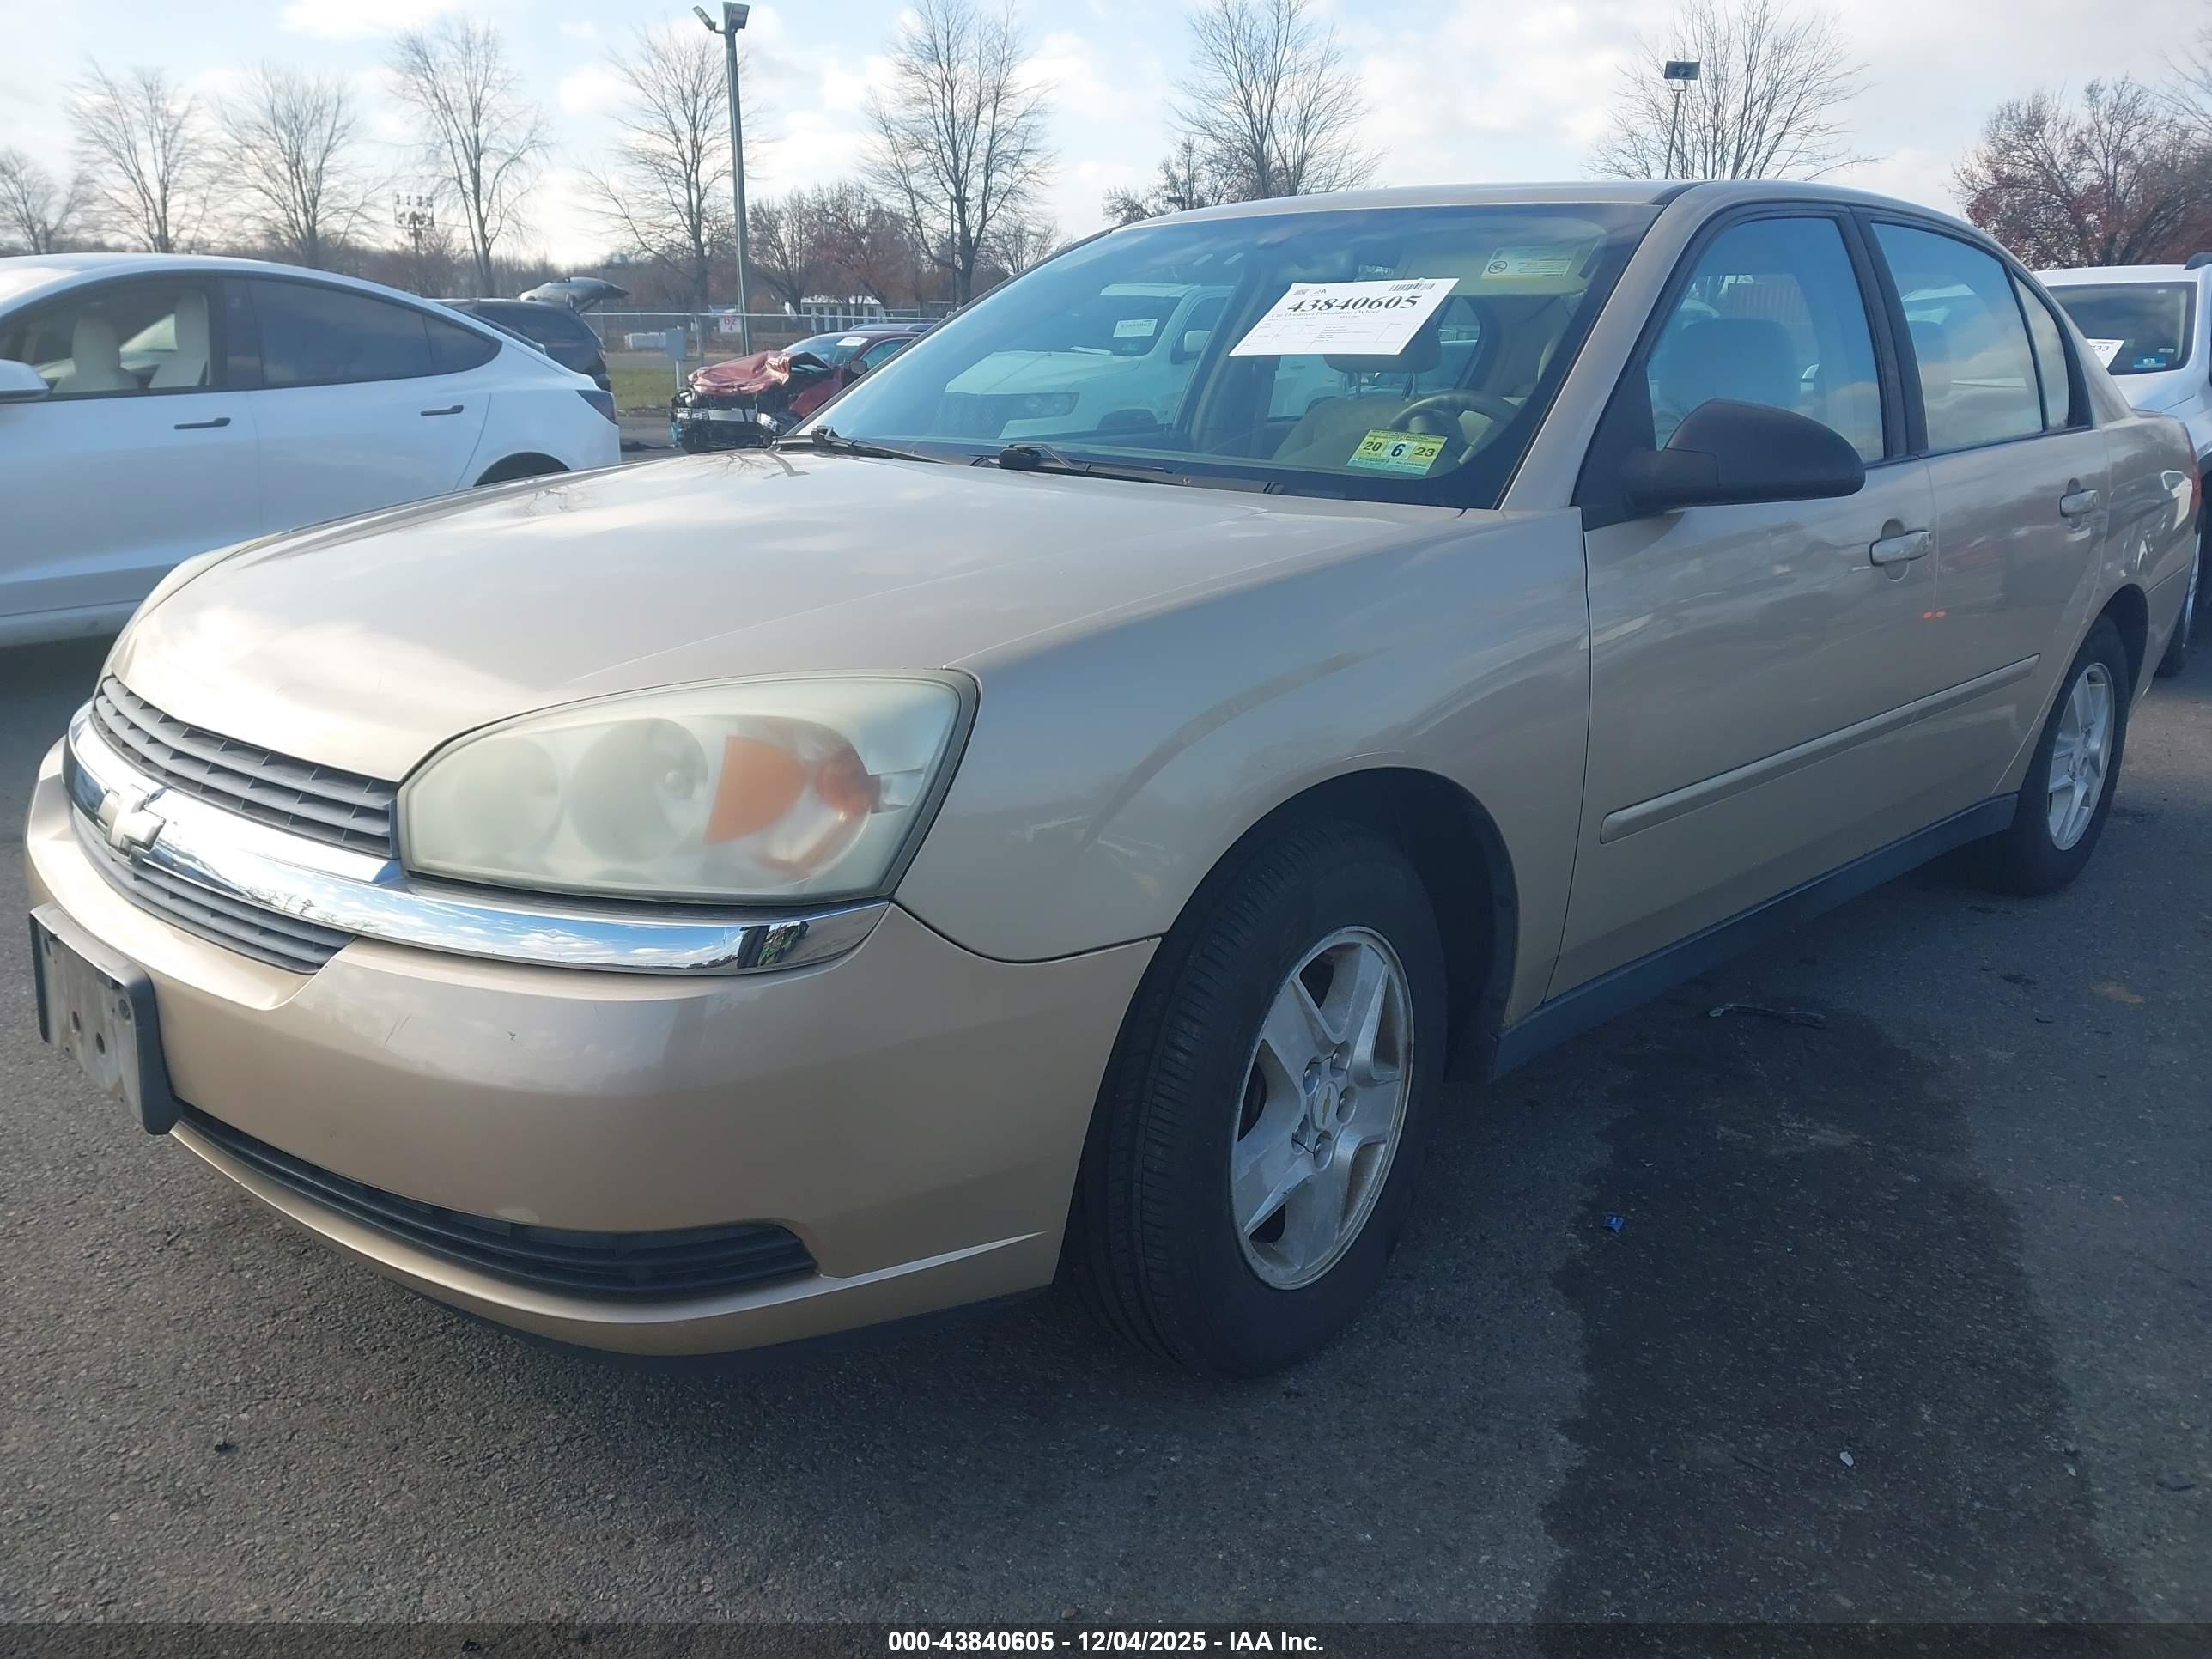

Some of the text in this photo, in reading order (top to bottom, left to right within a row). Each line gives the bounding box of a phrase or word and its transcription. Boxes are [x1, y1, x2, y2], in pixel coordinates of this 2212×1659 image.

[1287, 297, 1422, 312] 43840605
[1364, 441, 1435, 457] 20 6 23
